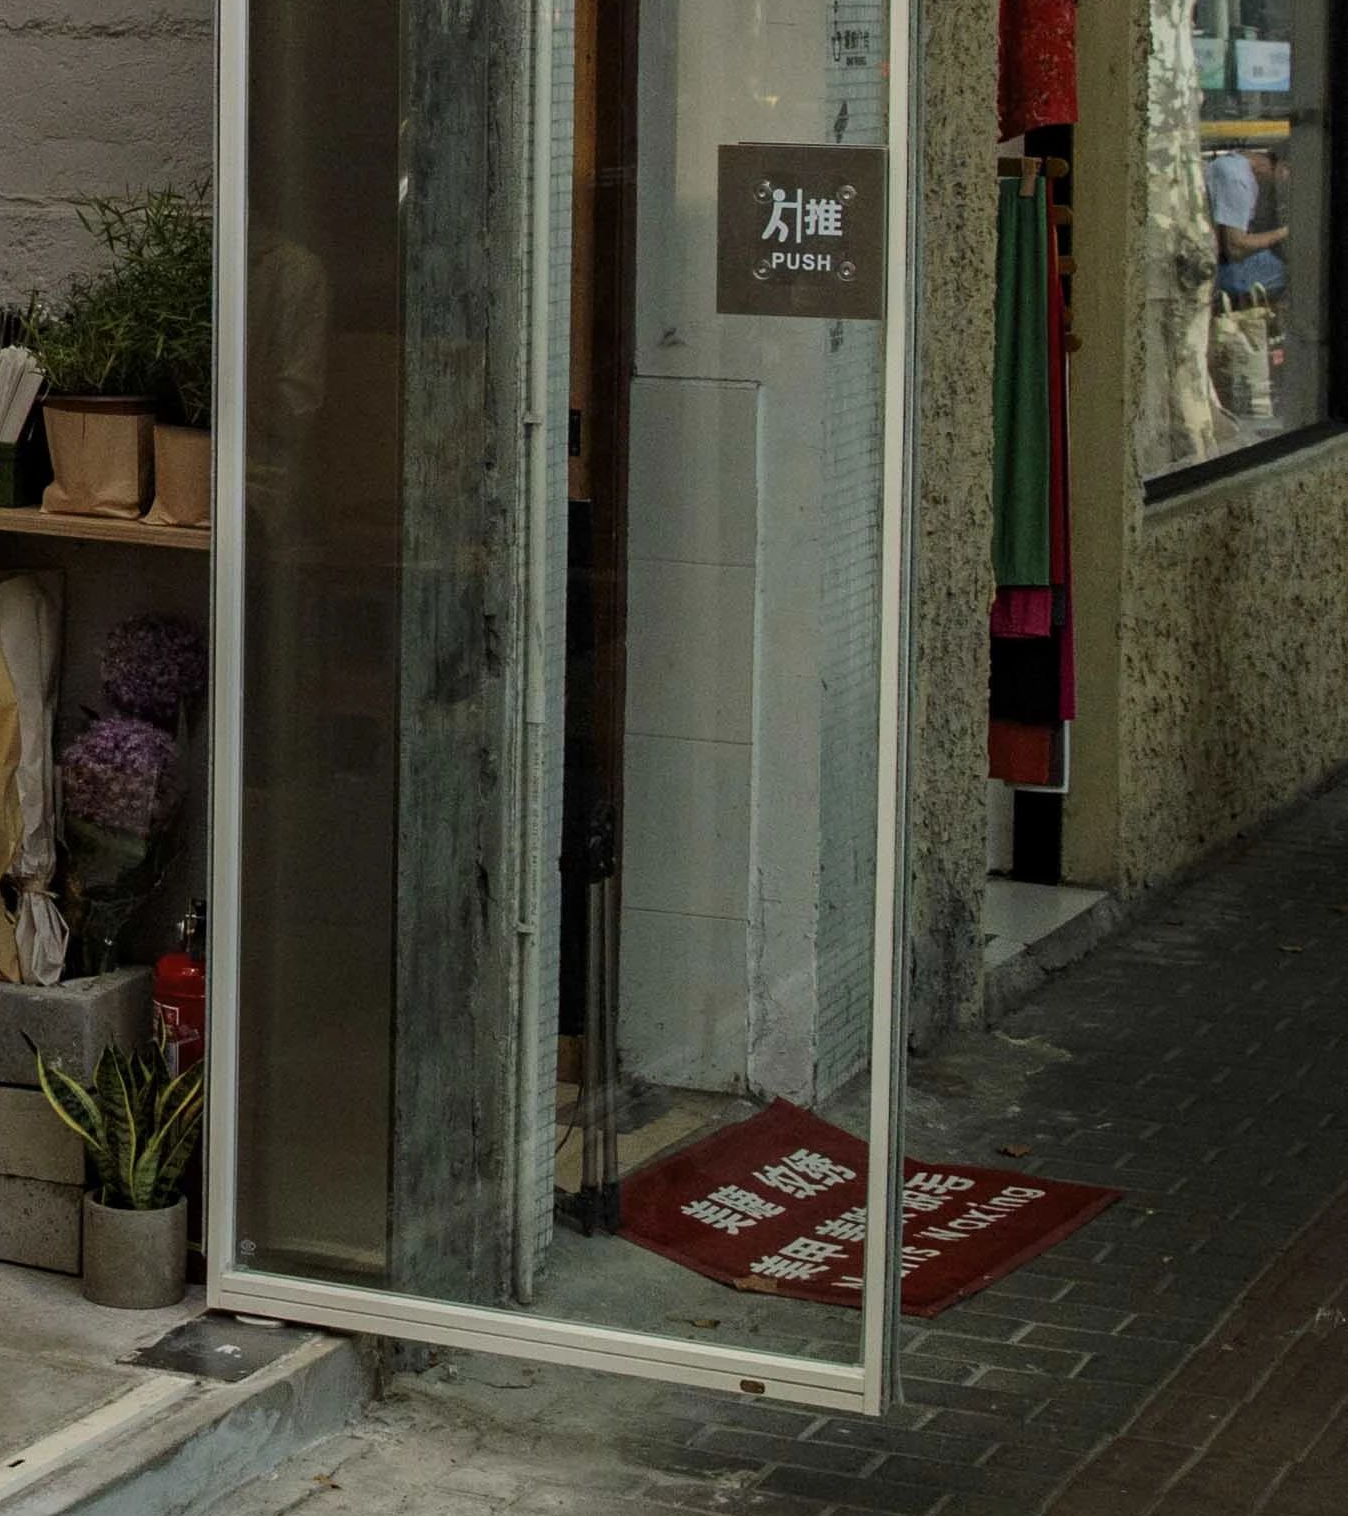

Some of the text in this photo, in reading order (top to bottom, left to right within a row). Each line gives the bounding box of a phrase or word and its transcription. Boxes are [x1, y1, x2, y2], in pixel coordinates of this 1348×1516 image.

[804, 197, 844, 237] 推
[771, 251, 832, 273] PUSH
[681, 1148, 857, 1235] 美睫 纹绣
[749, 1236, 850, 1281] 美甲
